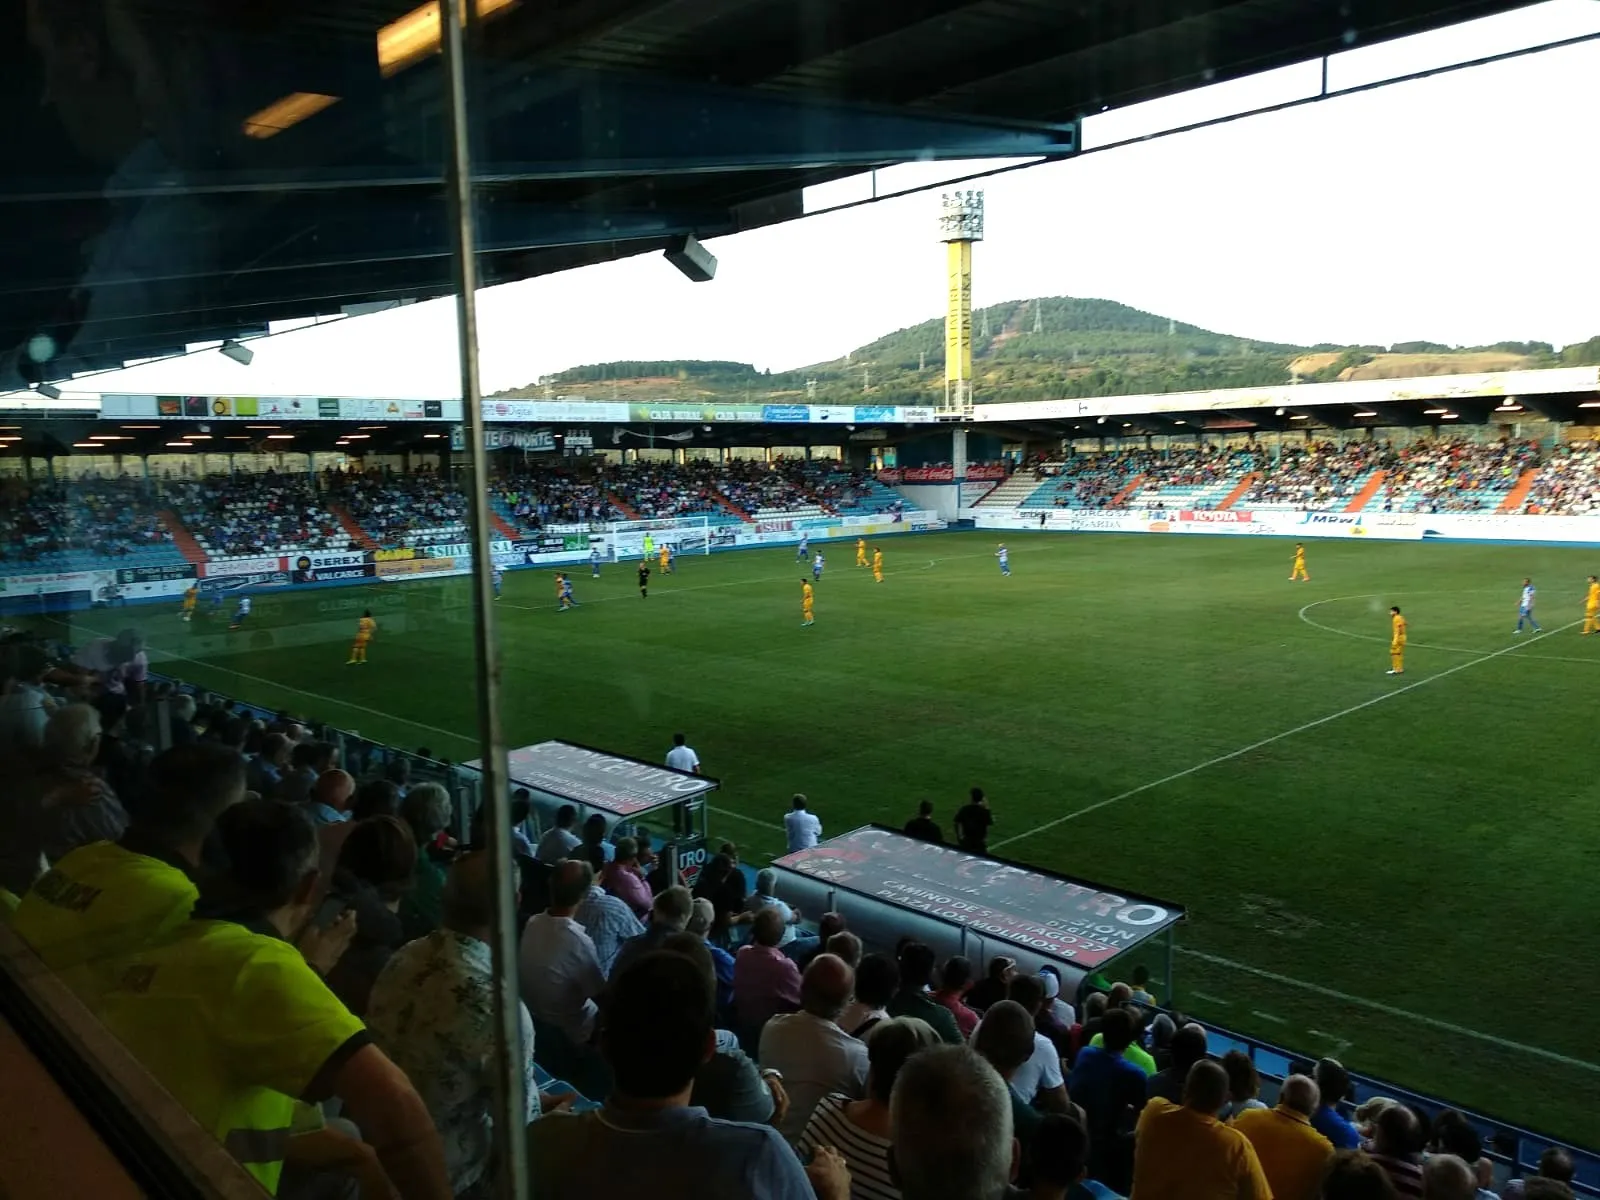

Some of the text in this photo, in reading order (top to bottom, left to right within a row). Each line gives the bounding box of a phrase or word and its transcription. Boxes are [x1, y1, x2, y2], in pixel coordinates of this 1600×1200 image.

[1192, 511, 1238, 522] TOYOTA
[313, 555, 362, 567] SEREX
[877, 889, 934, 912] PLAZA
[931, 907, 969, 922] LOS
[968, 917, 1061, 952] MOLINOS
[882, 879, 952, 905] CAMINO
[951, 899, 979, 914] DE
[1079, 941, 1110, 952] 27
[1046, 920, 1121, 946] DIGITAL
